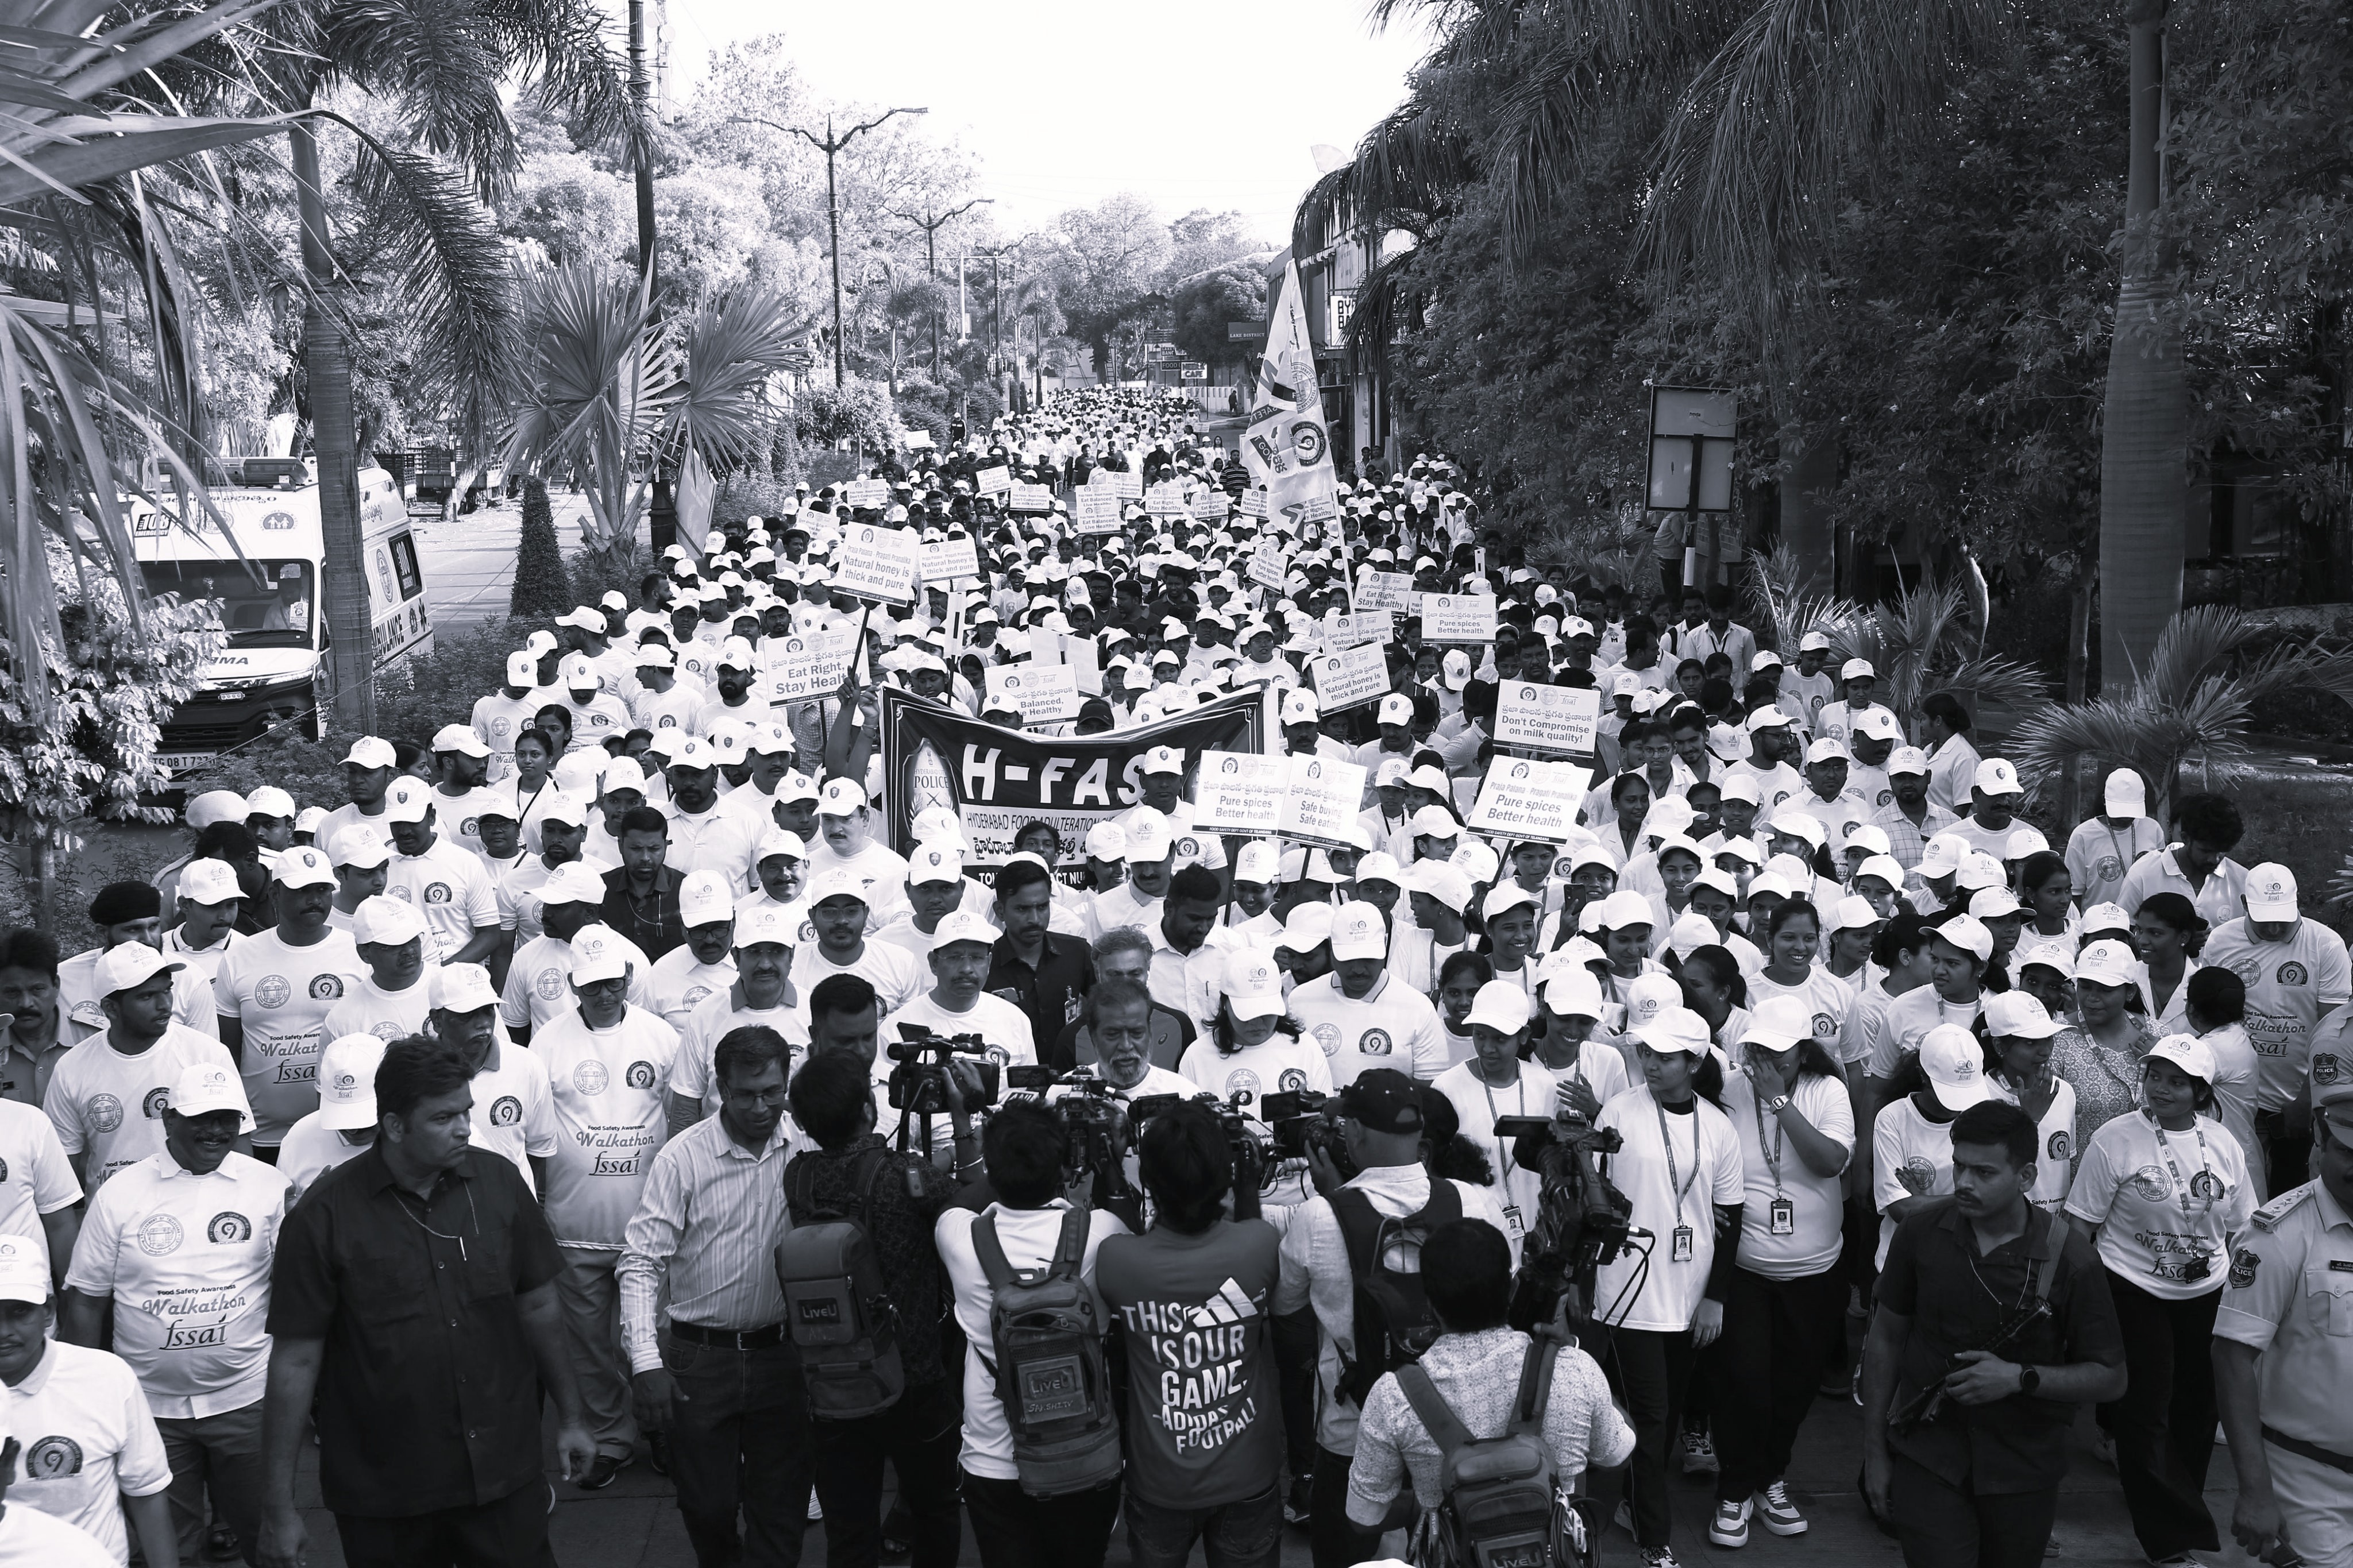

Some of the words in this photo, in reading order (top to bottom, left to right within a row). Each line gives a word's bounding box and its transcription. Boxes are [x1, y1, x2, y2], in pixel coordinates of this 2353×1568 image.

[1310, 510, 1332, 518] Healthy
[847, 546, 858, 554] Praja
[875, 551, 891, 561] Pragati
[843, 555, 874, 569] Natural
[875, 562, 901, 577] honey
[902, 567, 910, 577] is
[922, 560, 947, 568] Natural
[1257, 563, 1266, 571] Pure
[845, 569, 866, 582] thick
[867, 575, 884, 585] and
[885, 579, 904, 590] pure
[1357, 598, 1374, 608] Stay
[1375, 599, 1404, 609] Healthy
[788, 667, 808, 678] Eat
[811, 662, 845, 675] Right,
[777, 681, 806, 694] Stay
[1326, 682, 1351, 694] Natural
[1352, 675, 1373, 686] honey
[1331, 690, 1349, 701] thick
[1351, 686, 1363, 696] and
[1365, 682, 1380, 692] pure
[1020, 697, 1064, 708] Balanced,
[1029, 706, 1062, 716] Healthy
[1502, 715, 1527, 726] Don't
[1529, 719, 1590, 733] Compromise
[1523, 728, 1544, 738] milk
[1547, 732, 1583, 744] quality!
[167, 757, 179, 767] 08
[182, 757, 187, 766] T
[915, 776, 949, 789] POLICE
[1490, 782, 1506, 791] Praja
[1506, 785, 1526, 794] Palana
[1530, 787, 1552, 798] Pragati
[1552, 790, 1578, 801] Pranalika
[1220, 795, 1241, 805] Pure
[1243, 798, 1272, 808] spices
[1301, 800, 1318, 813] Safe
[1319, 804, 1344, 819] buying
[1496, 794, 1523, 808] Pure
[1525, 800, 1561, 813] spices
[966, 812, 1009, 830] HYDERABAD
[1216, 807, 1245, 818] Better
[1247, 810, 1276, 820] health
[1299, 813, 1317, 825] Safe
[1318, 818, 1341, 832] eating
[1487, 808, 1525, 823] Better
[1526, 813, 1563, 828] health
[273, 1059, 315, 1084] fssa
[576, 1131, 655, 1148] Walkathon
[588, 1149, 642, 1176] fssai
[2161, 1231, 2180, 1239] Safety
[2232, 1265, 2252, 1276] POLICE
[200, 1284, 236, 1292] Awareness
[142, 1293, 246, 1316] Walkathon
[1121, 1301, 1183, 1333] THIS
[159, 1313, 229, 1351] fssai
[1151, 1335, 1180, 1370] IS
[1184, 1324, 1245, 1369] OUR
[1161, 1359, 1248, 1409] GAME.
[1176, 1397, 1257, 1454] FOOTBALL
